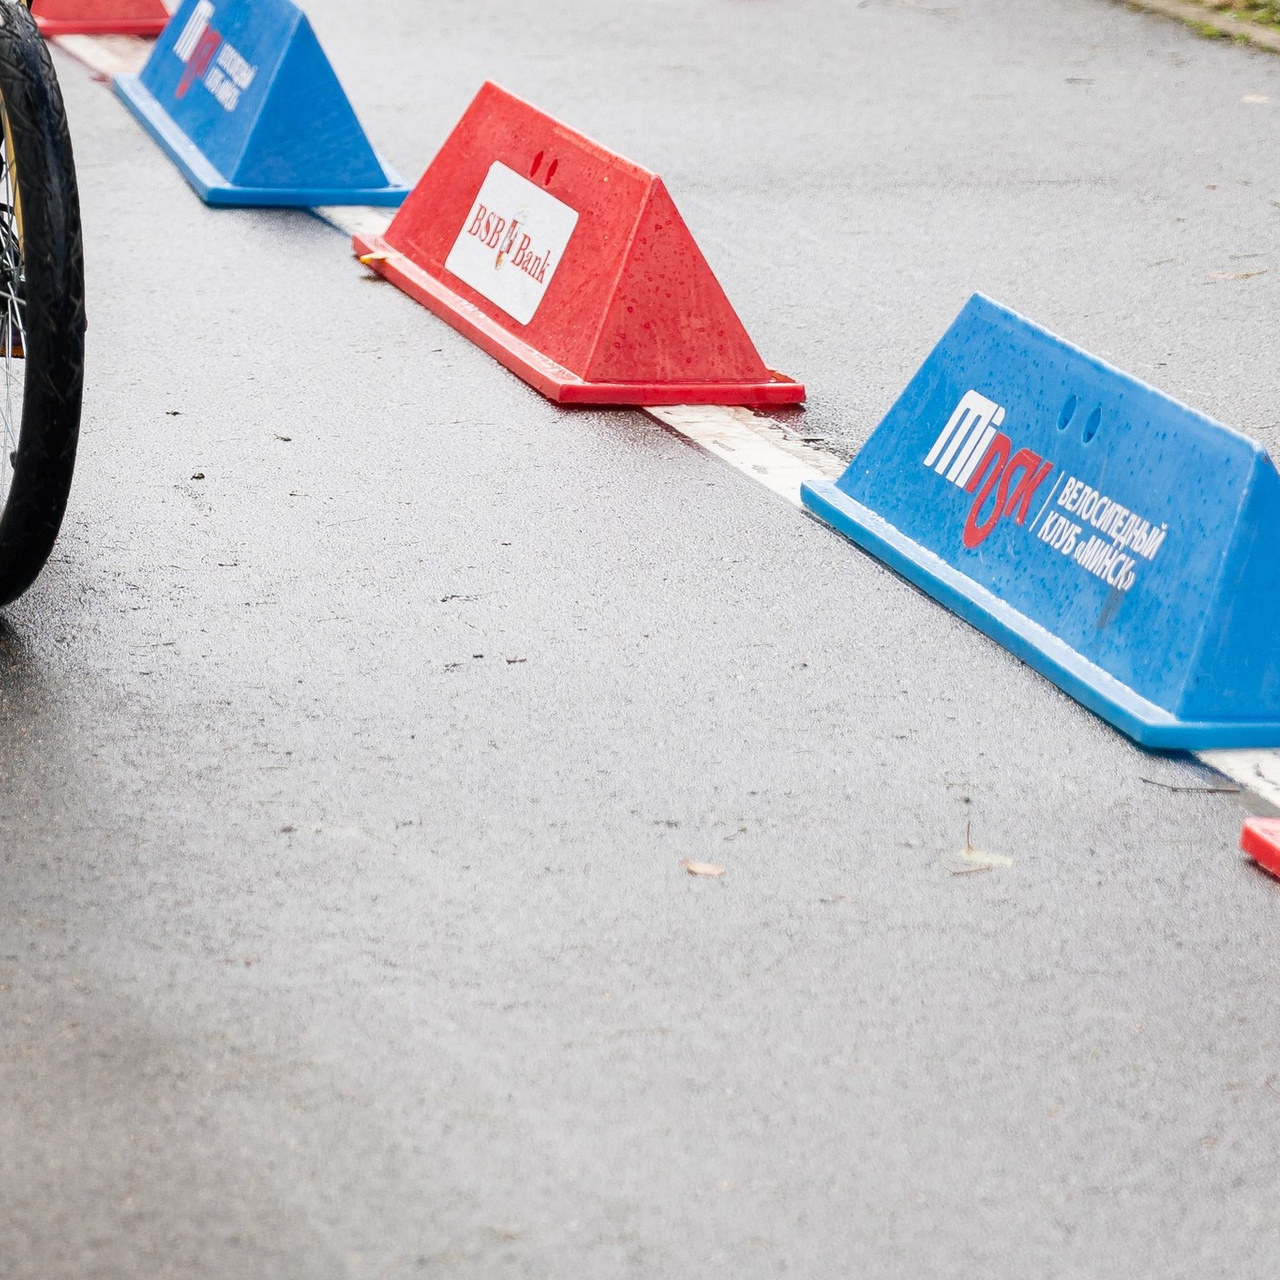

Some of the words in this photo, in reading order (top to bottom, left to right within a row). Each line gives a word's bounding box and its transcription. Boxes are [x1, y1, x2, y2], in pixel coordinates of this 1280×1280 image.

[468, 203, 506, 249] BSB
[510, 233, 551, 284] Bank
[1037, 510, 1082, 556] КЛУБ
[1073, 535, 1136, 590] «МИНСК»
[1057, 476, 1169, 560] ВЕЛОСИПЕДНЫЙ
